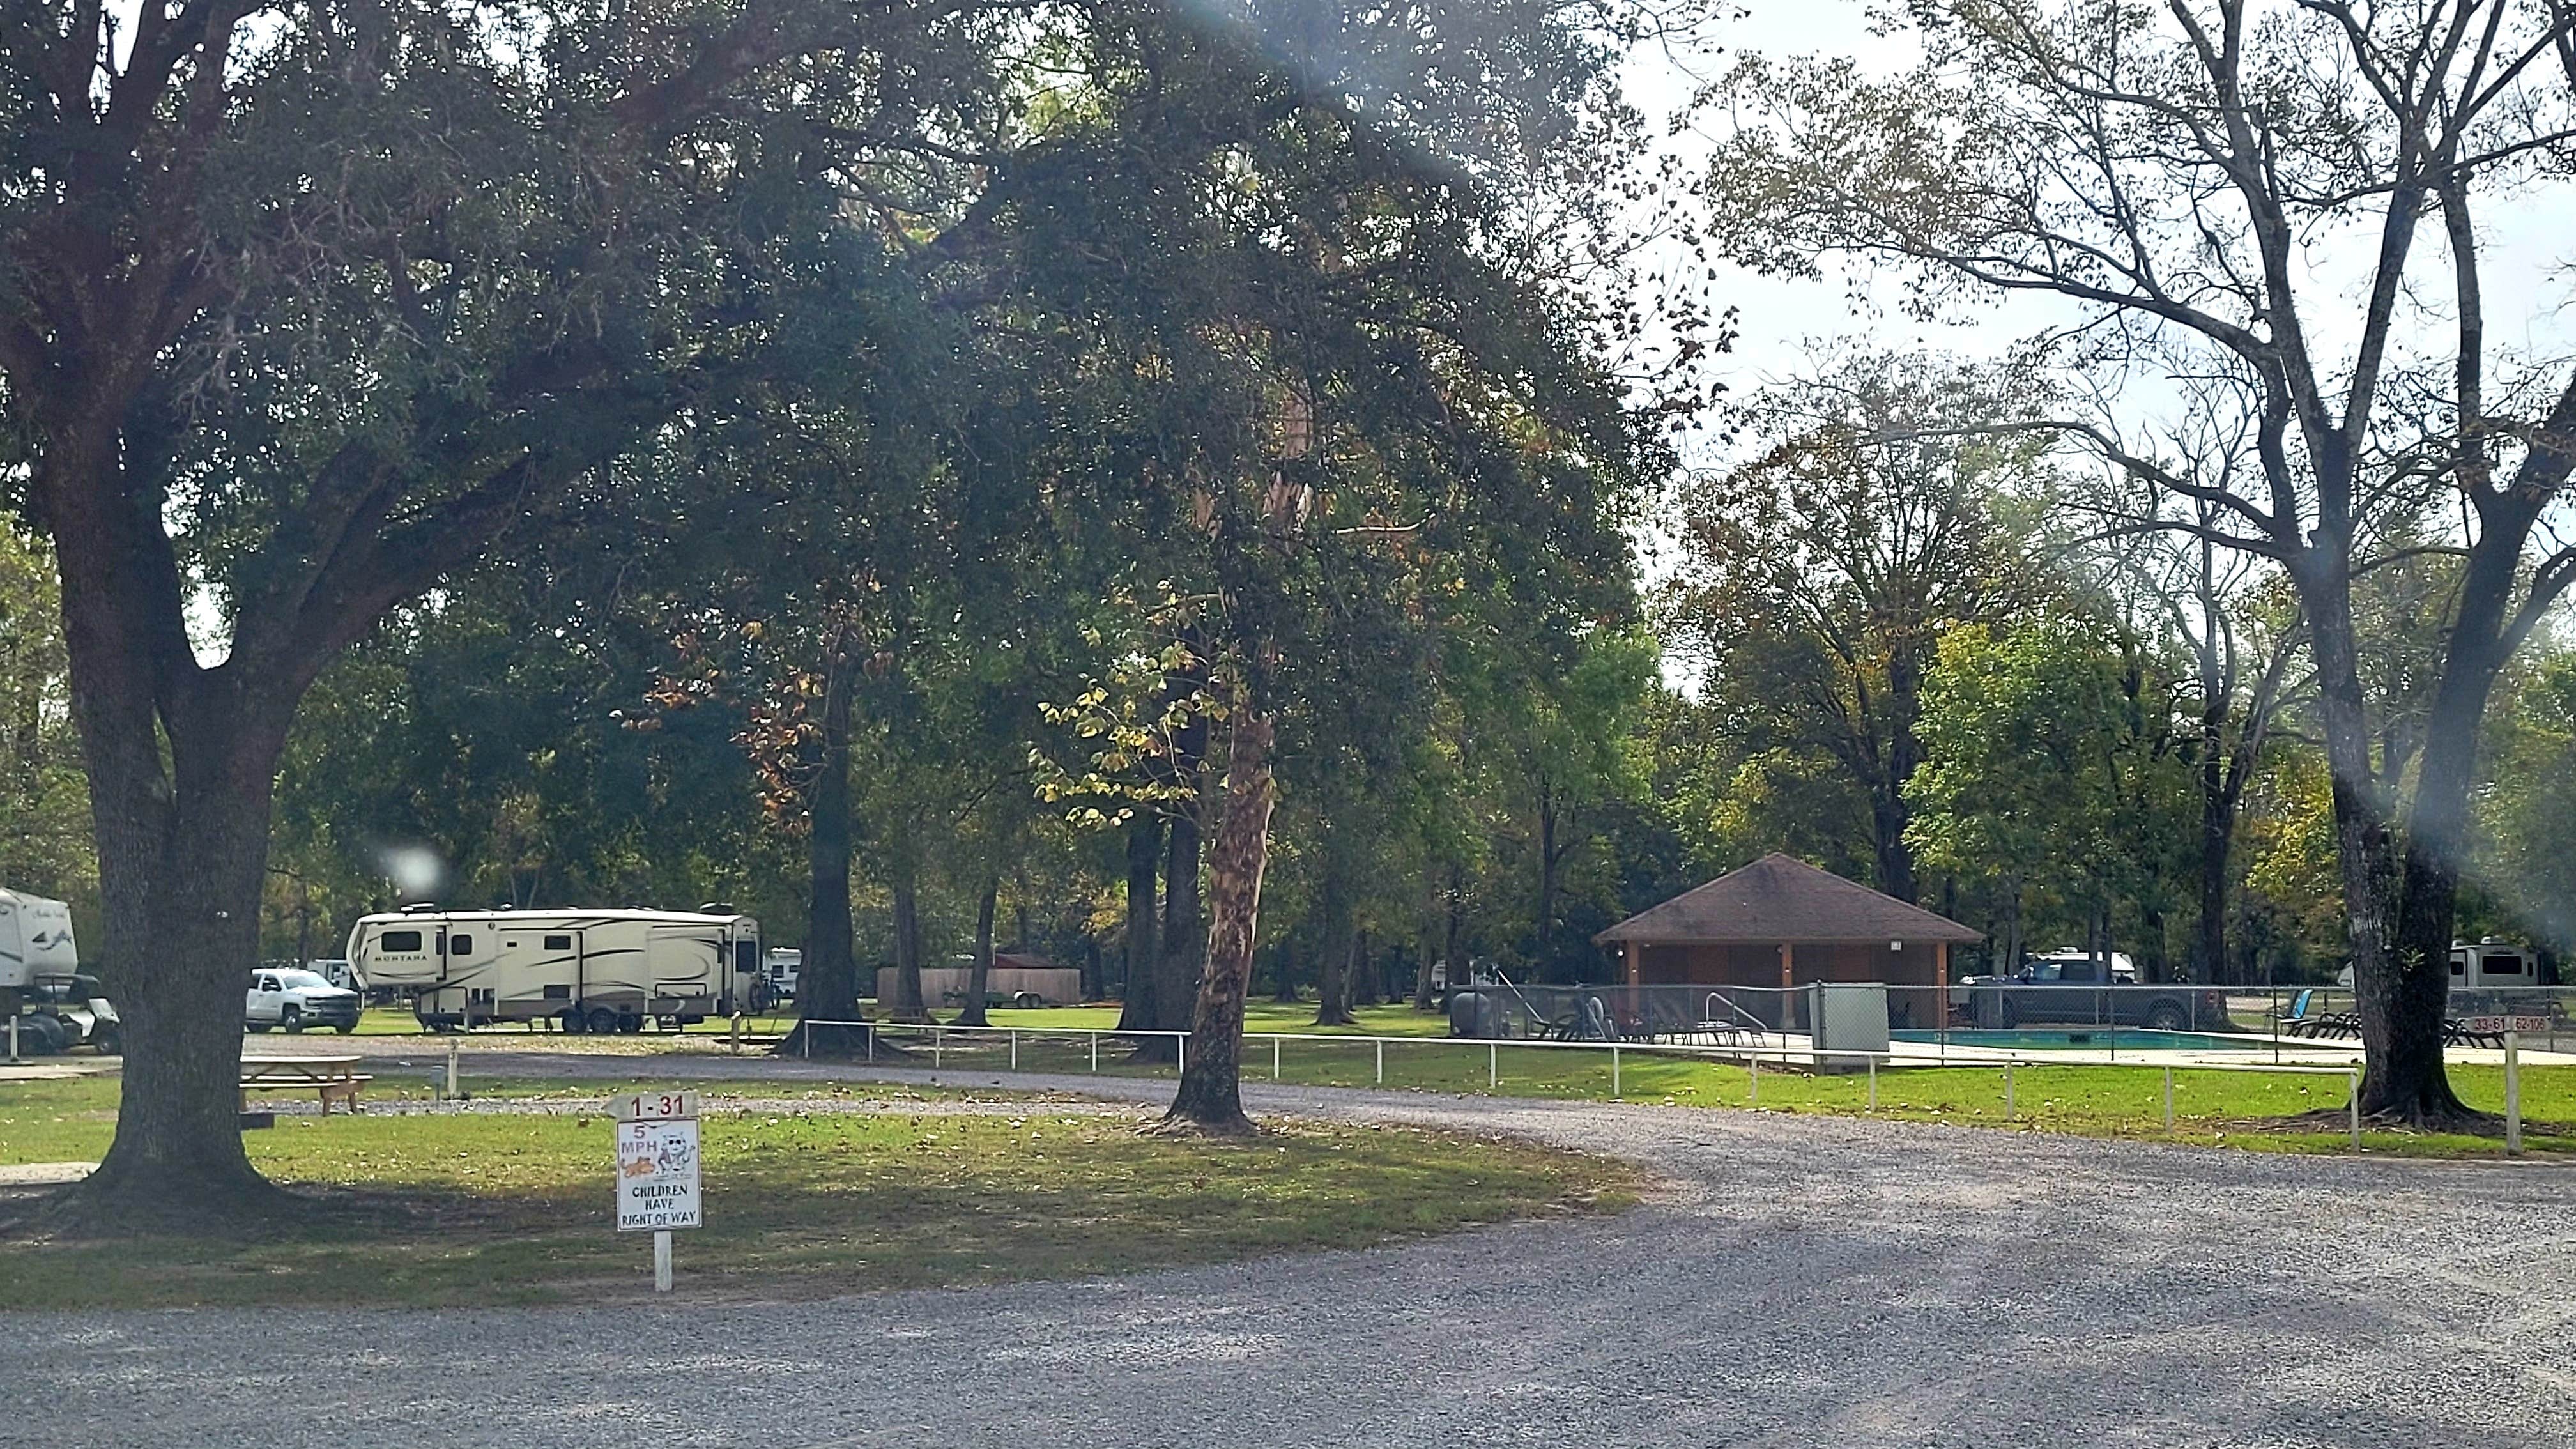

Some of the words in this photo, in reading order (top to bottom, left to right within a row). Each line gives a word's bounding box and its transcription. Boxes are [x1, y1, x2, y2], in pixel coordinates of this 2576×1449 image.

[2475, 1018, 2504, 1029] 33-61
[634, 1126, 645, 1138] 5
[622, 1142, 657, 1153] MPH
[632, 1184, 687, 1197] CHILDREN
[645, 1199, 674, 1211] HAVE
[622, 1213, 652, 1225] RIGHT
[655, 1213, 668, 1225] OF
[671, 1211, 696, 1223] WAY
